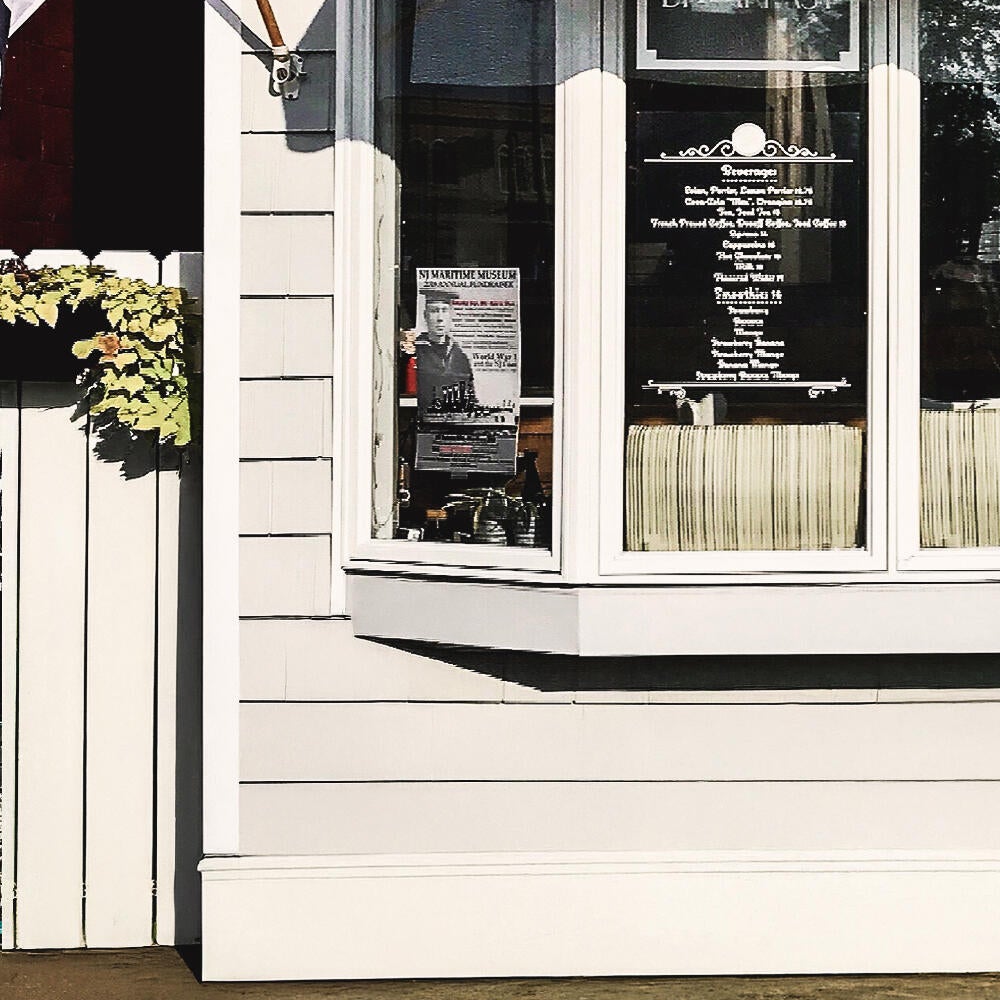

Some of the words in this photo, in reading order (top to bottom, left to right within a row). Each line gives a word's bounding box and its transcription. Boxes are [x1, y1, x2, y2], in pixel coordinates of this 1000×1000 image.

[720, 164, 778, 179] Beverages
[431, 270, 476, 280] MARITIME
[479, 270, 517, 280] MUSEUM
